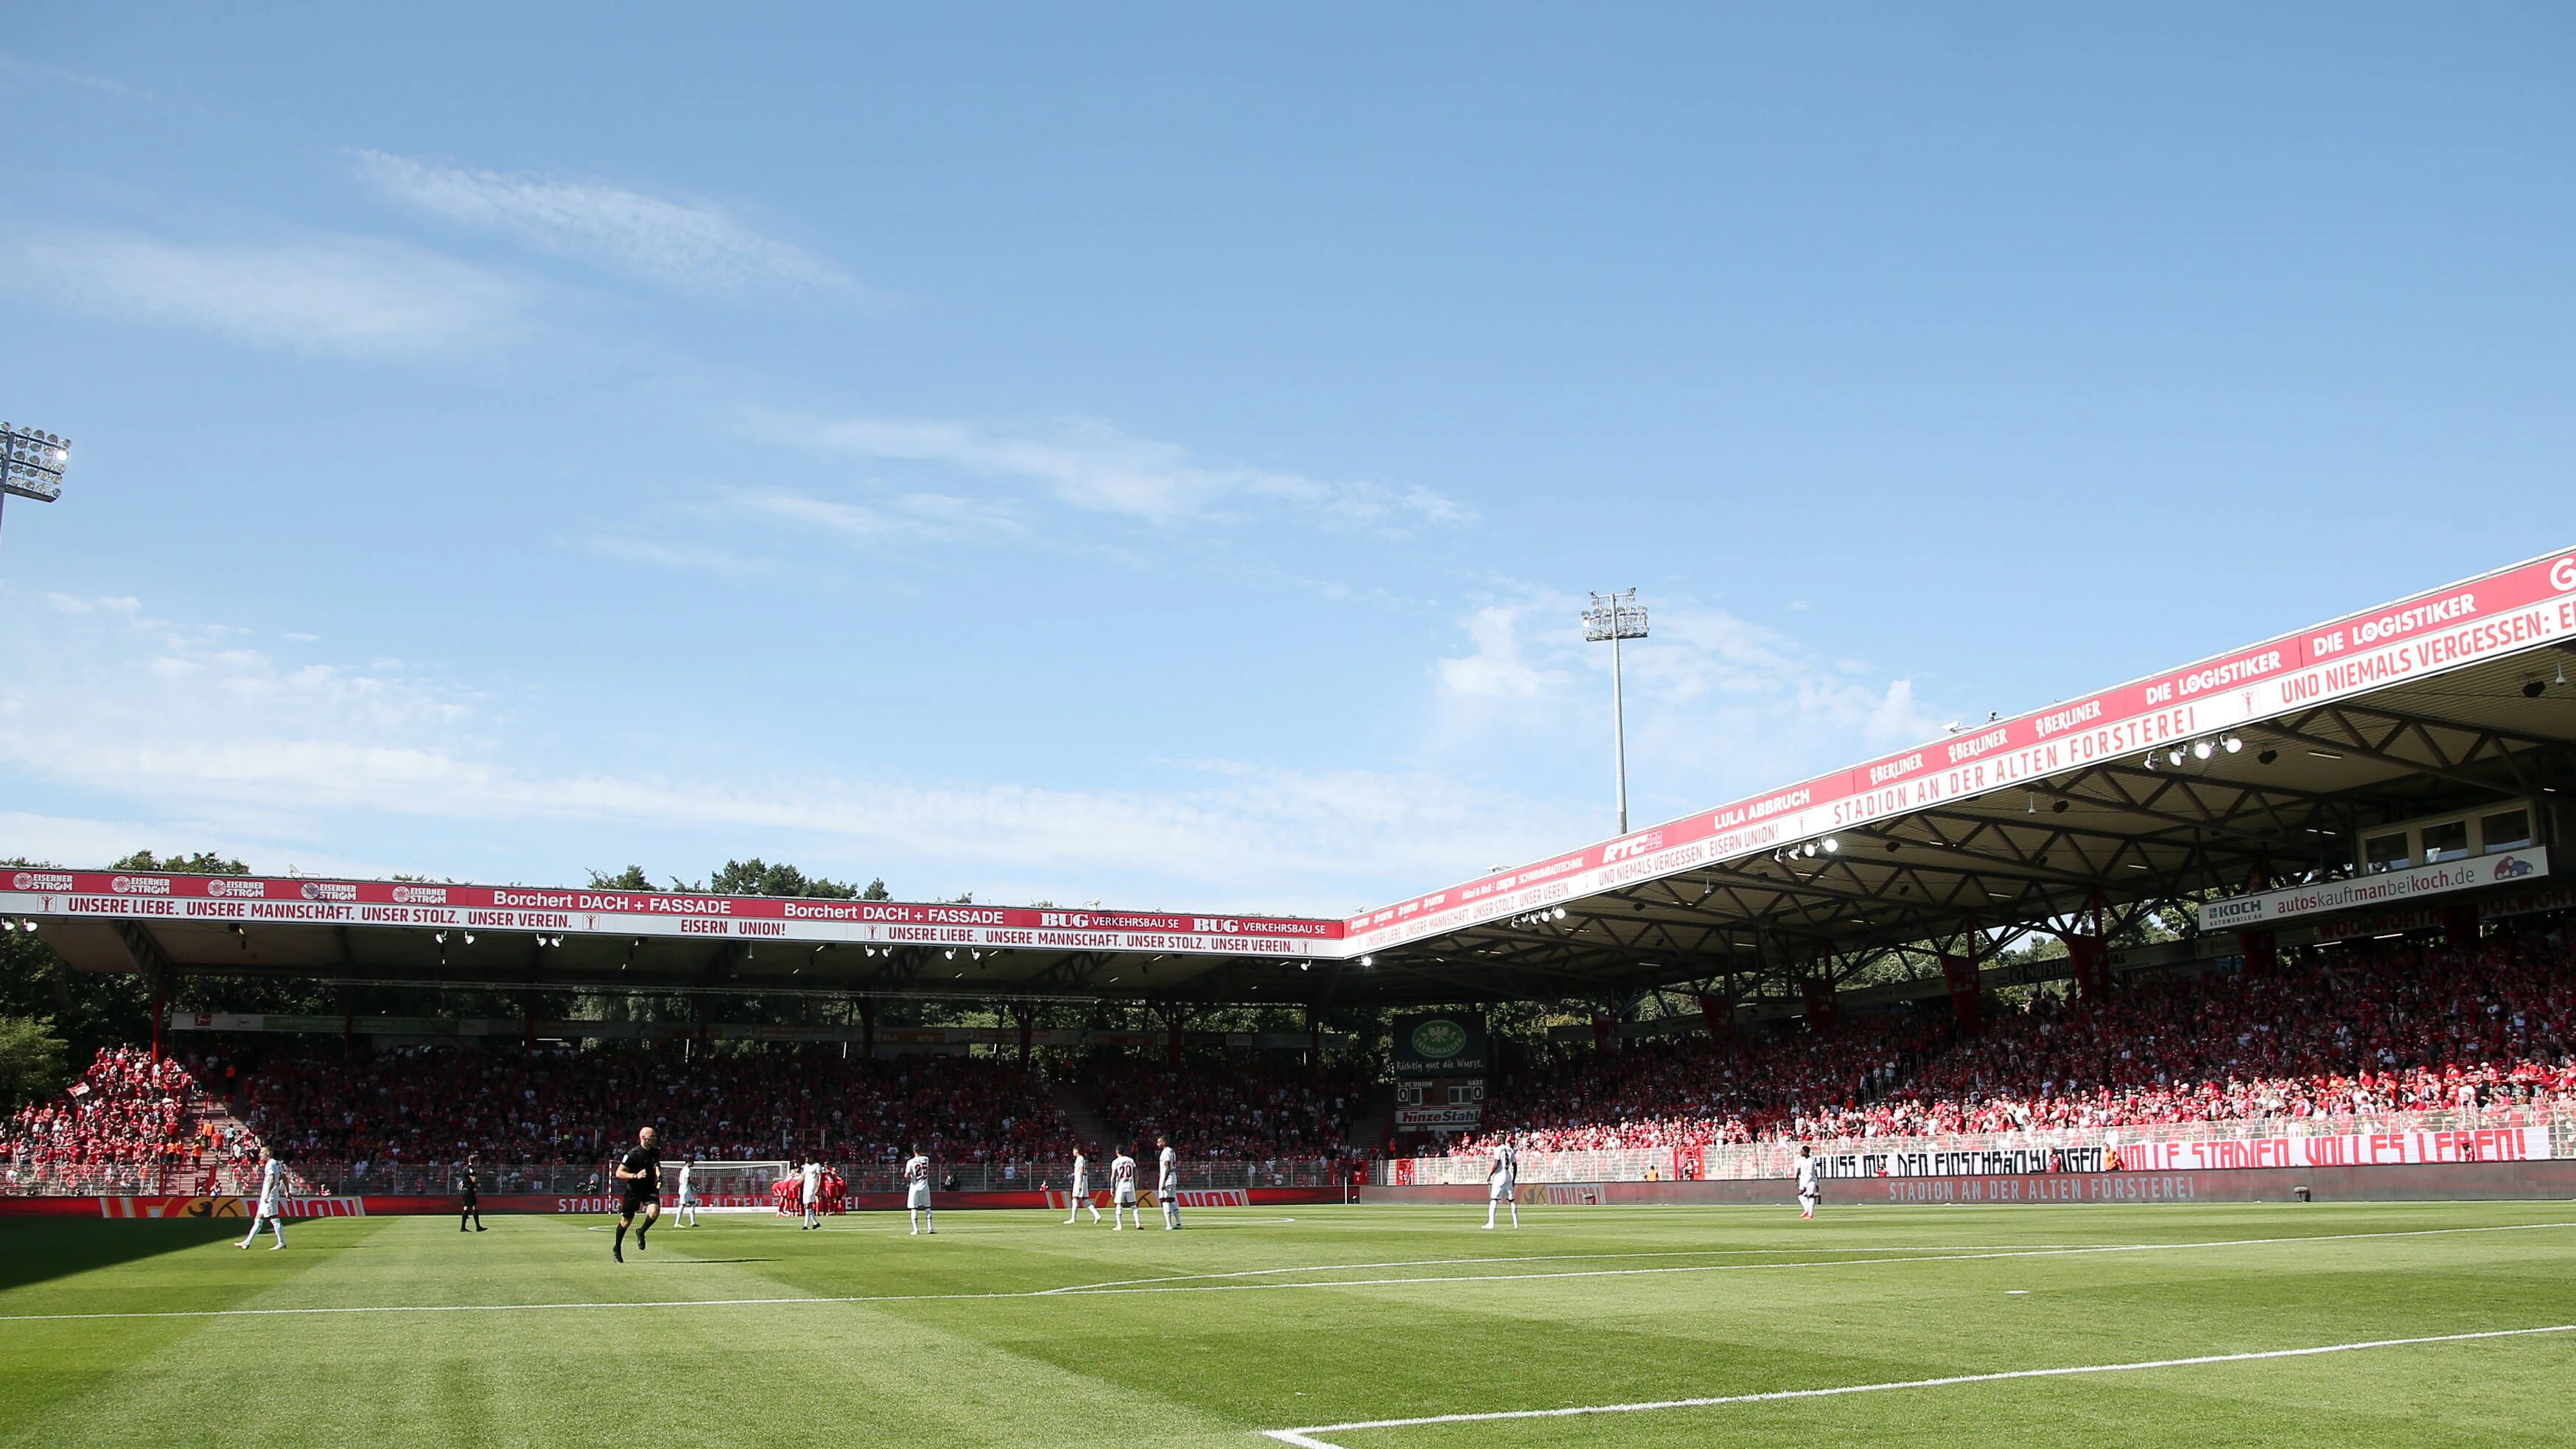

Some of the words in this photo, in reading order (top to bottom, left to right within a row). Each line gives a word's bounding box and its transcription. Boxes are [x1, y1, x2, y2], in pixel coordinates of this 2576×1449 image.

[2313, 631, 2343, 657] DIE
[2352, 593, 2477, 646] LOGISTIKER
[2281, 673, 2320, 705] UND
[2325, 647, 2412, 693] NIEMALS
[2417, 611, 2551, 667] VERGESSEN:
[2146, 682, 2171, 705] DIE
[2179, 650, 2282, 696] LOGISTIKER
[2043, 700, 2101, 733] BERLINER
[1955, 728, 2009, 759] BERLINER
[1834, 786, 1907, 825] STADION
[1918, 778, 1940, 803] AN
[1950, 766, 1985, 794] DER
[1996, 744, 2057, 783] ALTEN
[2070, 706, 2195, 763] FÖRSTEREI
[1878, 753, 1924, 783] BERLINER
[1714, 810, 1746, 830] LULA
[1748, 789, 1810, 820] ABBRUCH
[1599, 868, 1614, 886] UND
[1617, 858, 1651, 881] NIEMALS
[1654, 845, 1705, 871] VERGESSEN:
[1709, 835, 1742, 857] EISERN
[1744, 823, 1779, 848] UNION!
[33, 874, 73, 883] EISERNER
[130, 878, 169, 886] EISERNER
[1519, 856, 1584, 884] SCHWIMMBADTECHNIK
[226, 881, 265, 889] EISERNER
[320, 884, 357, 893] EISERNER
[410, 887, 447, 895] EISERNER
[2278, 868, 2475, 914] autoskauftmanbeikoch.de
[69, 898, 128, 913] UNSERE
[133, 900, 179, 915] LIEBE.
[186, 901, 245, 917] UNSERE
[251, 904, 354, 920] MANNSCHAFT.
[362, 907, 408, 921] UNSER
[413, 908, 460, 923] STOLZ.
[469, 911, 513, 926] UNSER
[519, 913, 572, 928] VEREIN.
[494, 890, 573, 908] Borchert
[579, 895, 629, 910] DACH
[634, 900, 644, 910] +
[650, 898, 731, 914] FASSADE
[785, 903, 858, 919] Borchert
[864, 907, 909, 921] DACH
[914, 911, 923, 921] +
[928, 909, 1004, 924] FASSADE
[1366, 931, 1386, 948] UNSERE
[1406, 919, 1427, 937] UNSERE
[1429, 908, 1471, 930] MANNSCHAFT.
[1474, 901, 1493, 919] UNSER
[1495, 895, 1516, 914] STOLZ.
[1519, 888, 1541, 907] UNSER
[1543, 881, 1572, 901] VEREIN.
[2219, 899, 2261, 917] KOCH
[681, 919, 728, 934] EISERN
[739, 921, 785, 936] UNION!
[1040, 912, 1088, 927] BUG
[1092, 916, 1166, 928] VERKEHRSBAU
[1168, 919, 1179, 929] SE
[1193, 918, 1239, 933] BUG
[1243, 922, 1313, 934] VERKEHRSBAU
[1315, 925, 1326, 935] SE
[2210, 915, 2251, 926] AUTOMOBILE
[889, 926, 937, 941] UNSERE
[940, 929, 978, 943] LIEBE.
[986, 930, 1032, 944] UNSERE
[1038, 932, 1121, 947] MANNSCHAFT.
[1127, 935, 1164, 949] UNSER
[1168, 936, 1205, 950] STOLZ.
[1211, 938, 1248, 952] UNSER
[1251, 940, 1295, 953] VEREIN.
[1414, 1037, 1464, 1055] EBERSWALDER
[1426, 1061, 1441, 1072] gut
[1443, 1059, 1455, 1069] die
[2306, 1134, 2405, 1166] VOLLES
[914, 1162, 928, 1177] 25
[1119, 1165, 1132, 1179] 20
[1889, 1181, 1953, 1201] STADION
[1961, 1179, 1981, 1200] AN
[1989, 1179, 2020, 1200] DER
[2029, 1179, 2082, 1199] ALTEN
[2090, 1173, 2194, 1199] FÖRSTEREI
